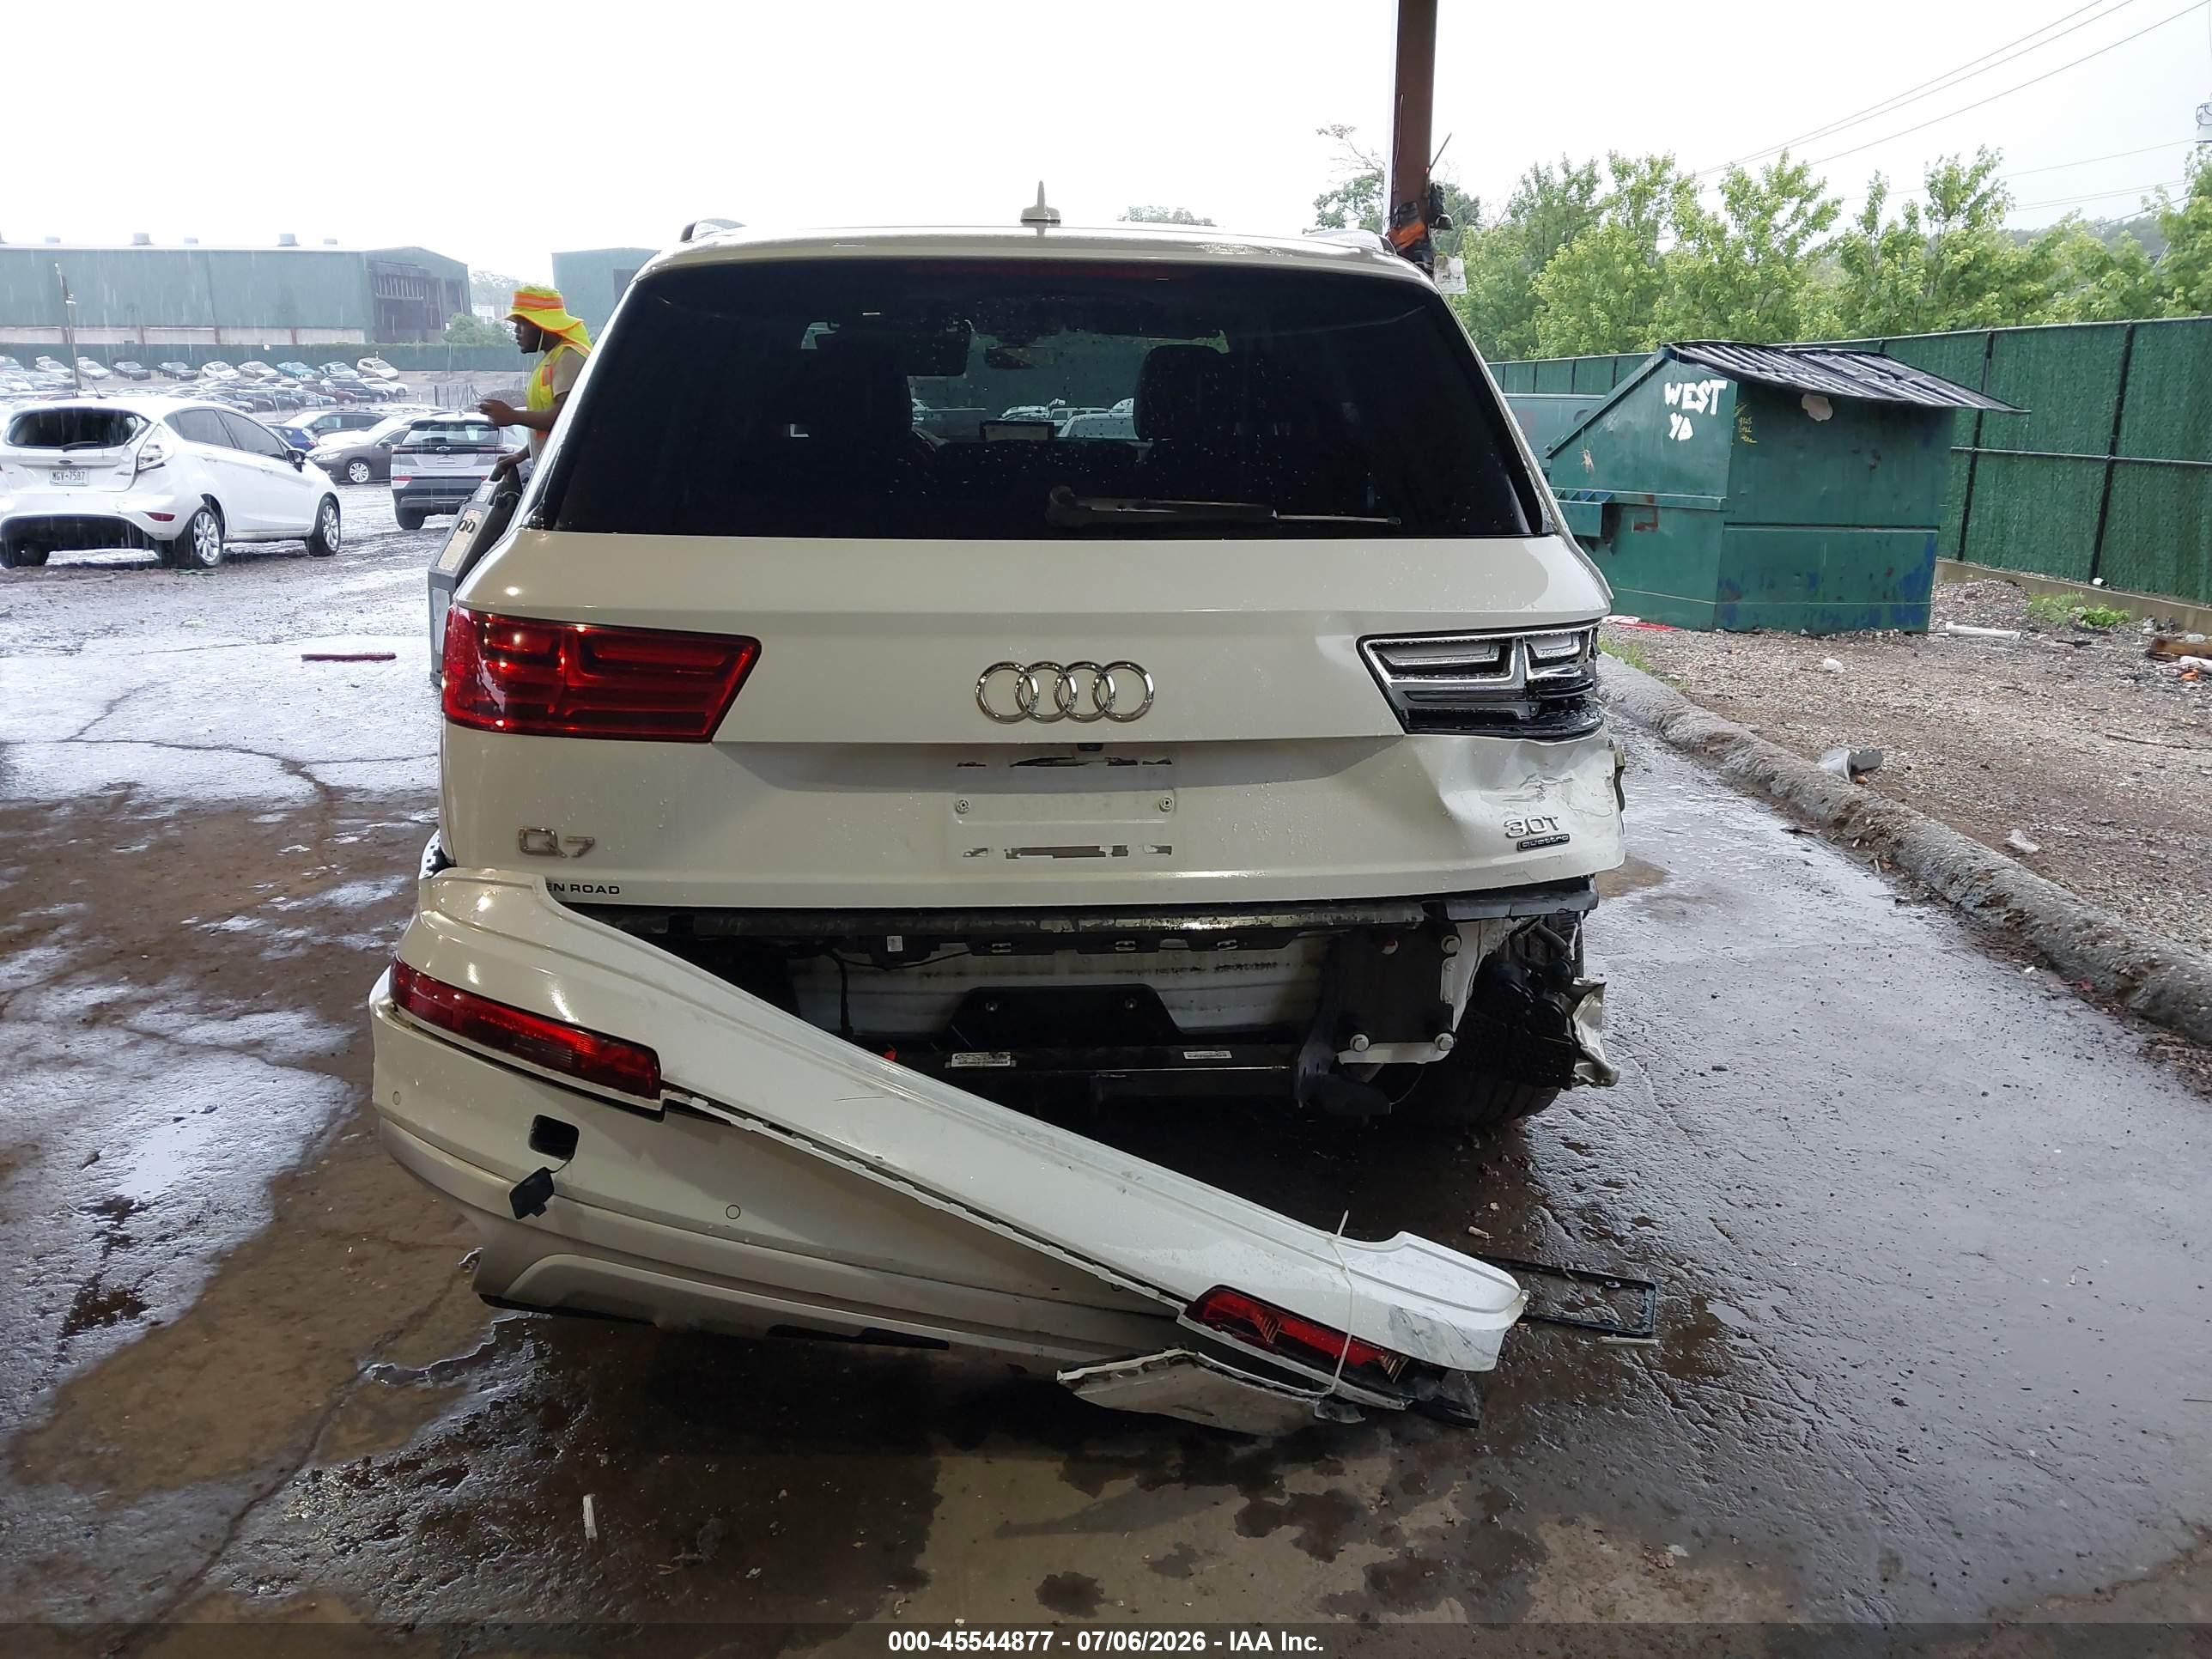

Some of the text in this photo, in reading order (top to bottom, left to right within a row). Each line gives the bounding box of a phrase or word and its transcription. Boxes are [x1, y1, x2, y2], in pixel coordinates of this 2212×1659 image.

[1665, 380, 1728, 415] WEST
[518, 827, 595, 858] Q7
[1521, 835, 1570, 848] quattro
[569, 884, 620, 894] ROAD
